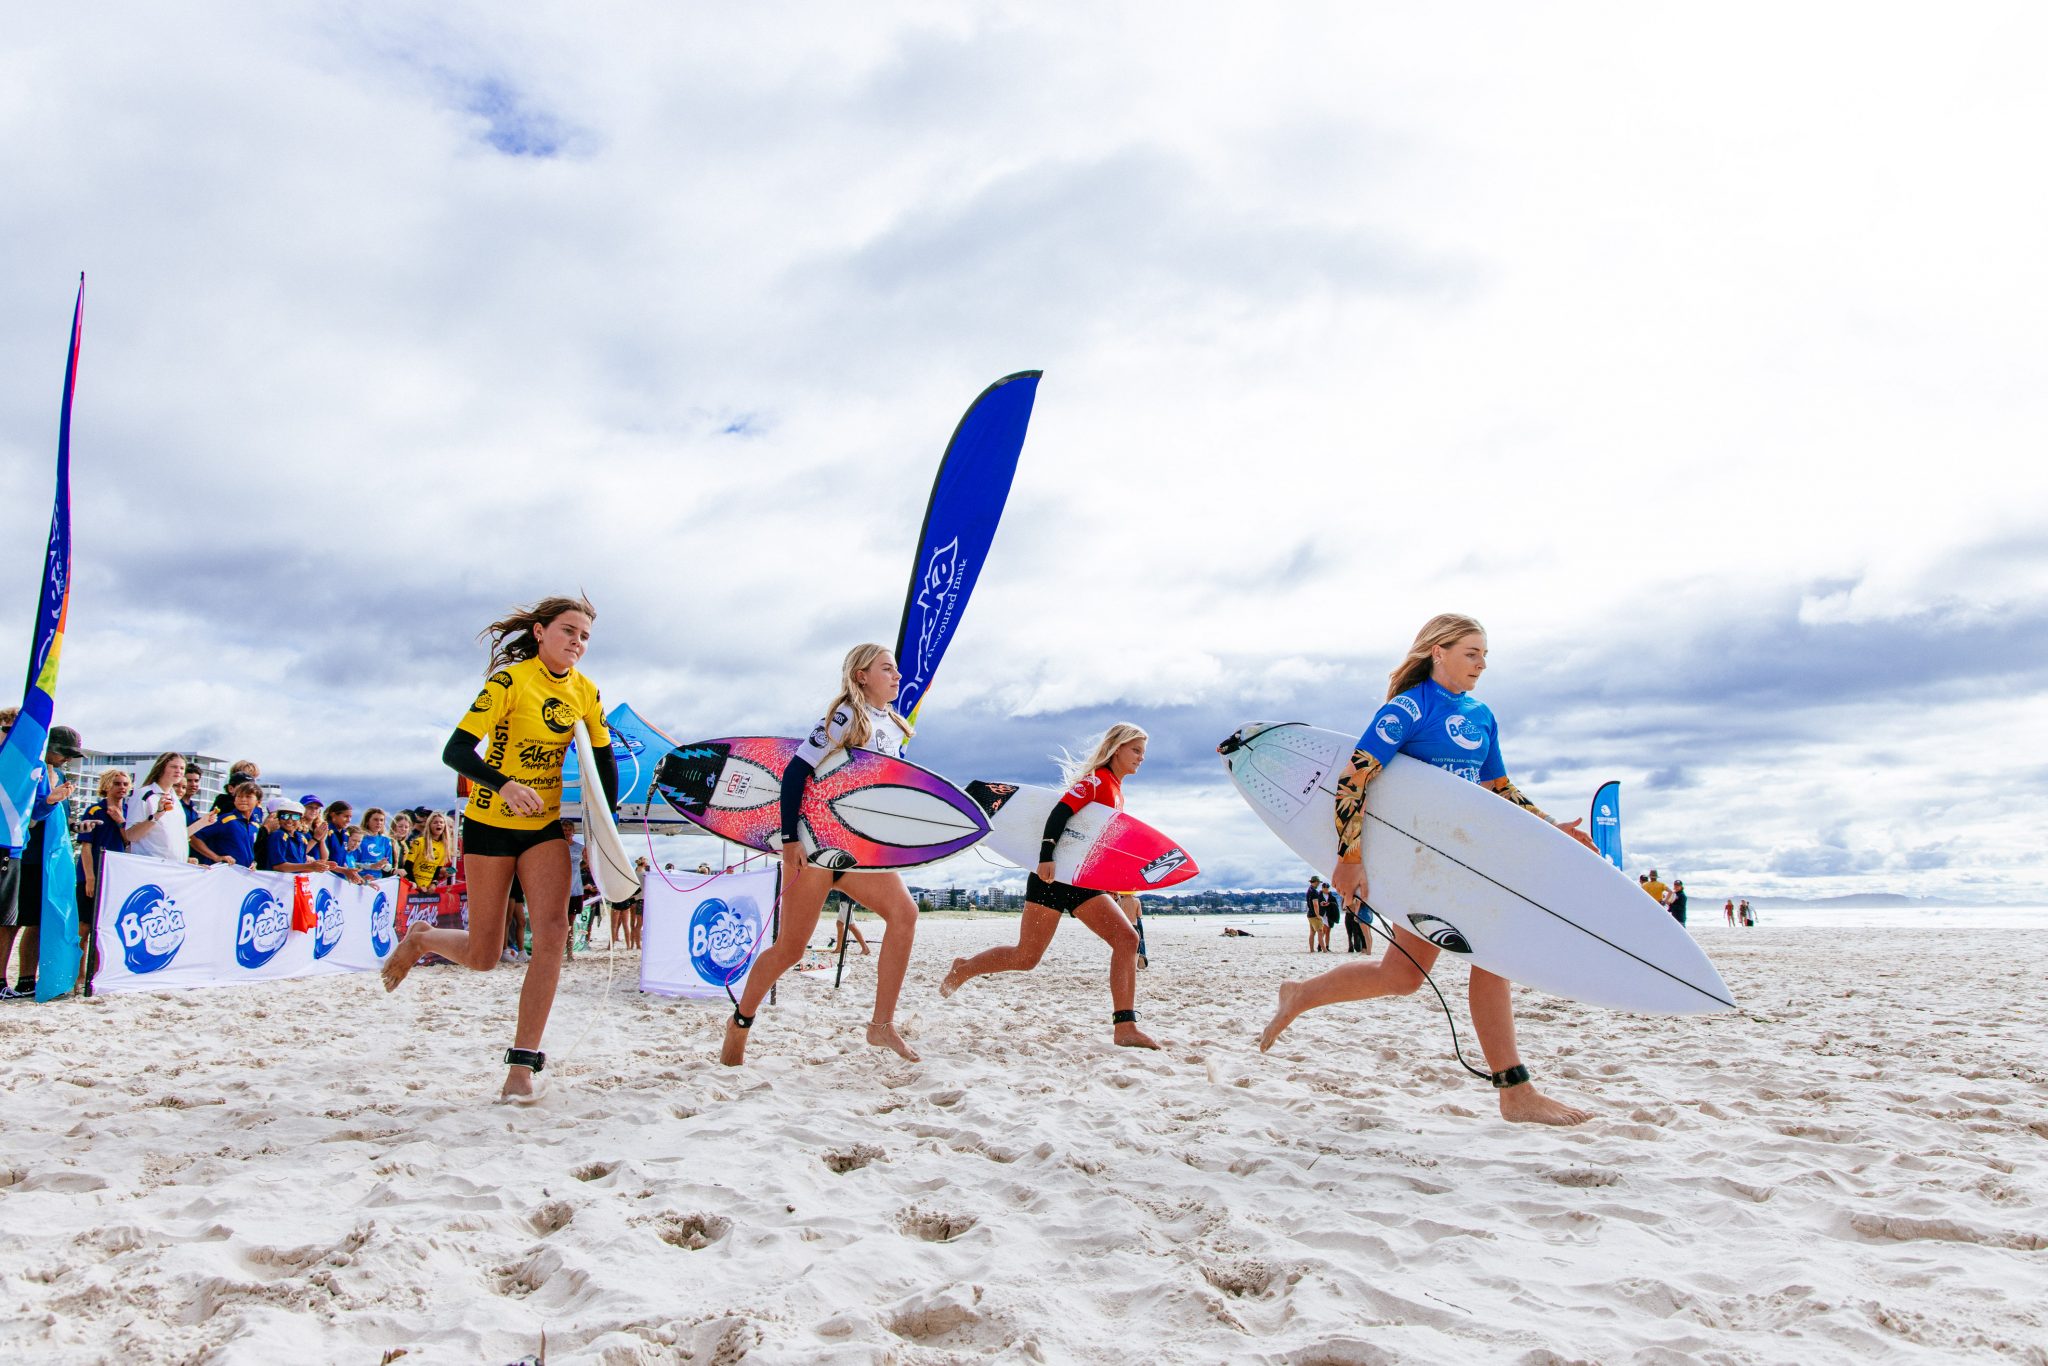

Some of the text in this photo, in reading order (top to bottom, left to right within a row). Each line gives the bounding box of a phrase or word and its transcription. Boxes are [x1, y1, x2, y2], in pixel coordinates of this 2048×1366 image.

[952, 558, 968, 592] milk
[1140, 848, 1181, 874] CARVE
[121, 909, 186, 948] Breaka
[238, 909, 290, 946] Breaka
[315, 909, 345, 939] Breaka
[692, 921, 753, 958] Breaka
